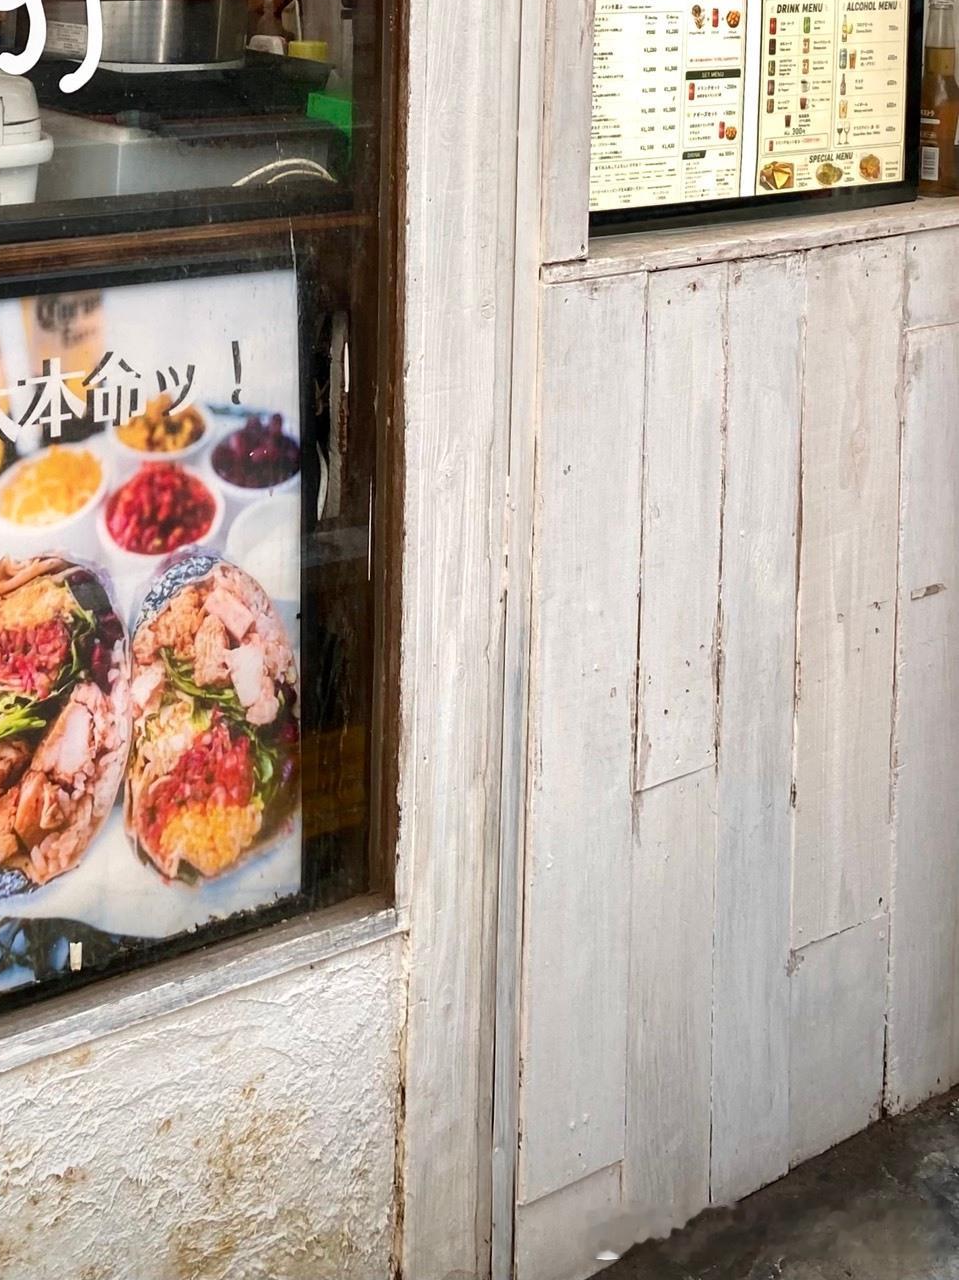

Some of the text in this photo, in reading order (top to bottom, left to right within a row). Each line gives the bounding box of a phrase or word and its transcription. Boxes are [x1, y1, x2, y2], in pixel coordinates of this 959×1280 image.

[776, 3, 823, 14] DRINK MENU
[846, 1, 898, 12] ALCOHOL MENU
[809, 151, 854, 164] SPECIAL MENU
